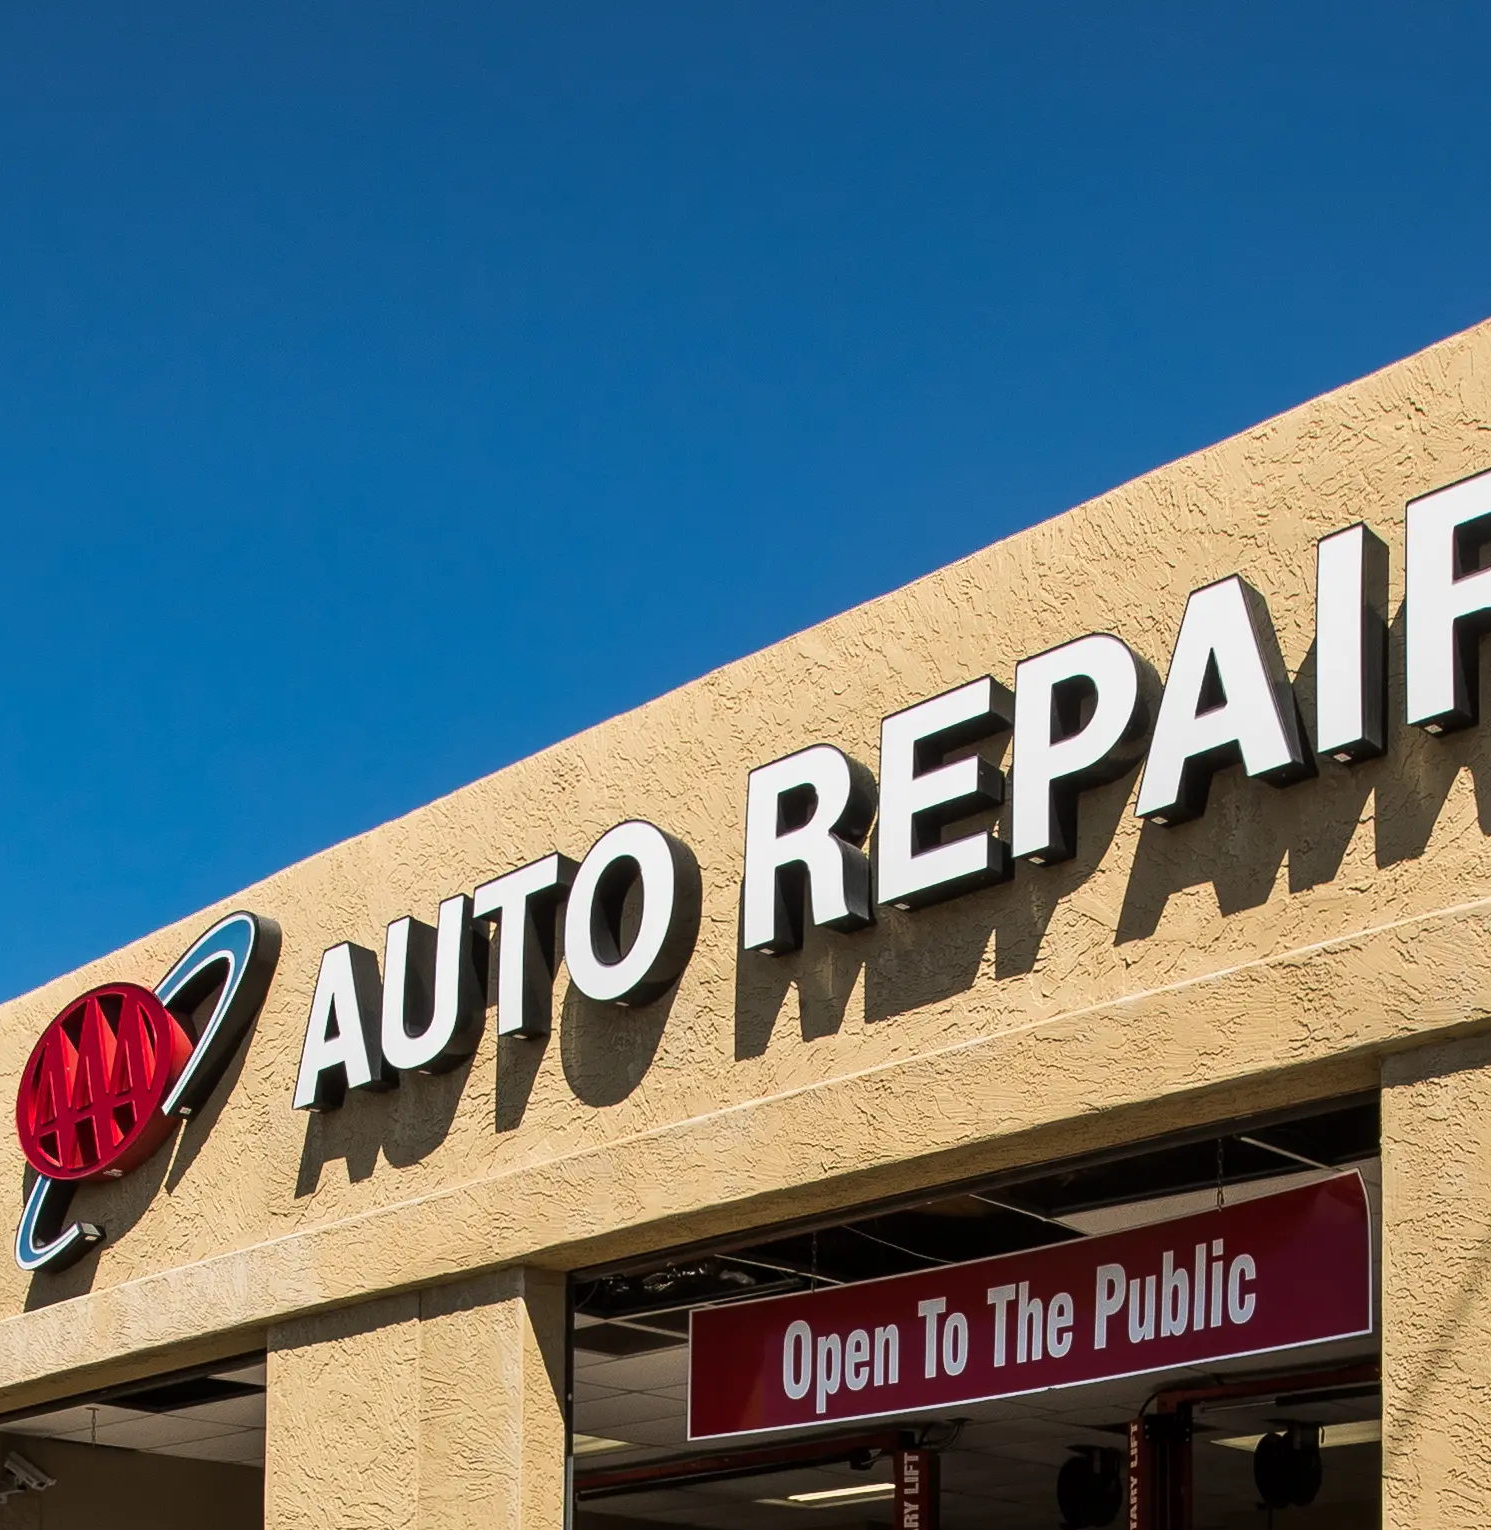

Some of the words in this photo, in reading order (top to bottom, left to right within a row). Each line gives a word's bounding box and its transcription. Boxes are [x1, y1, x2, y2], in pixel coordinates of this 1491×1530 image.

[293, 820, 678, 1112] AUTO
[16, 984, 170, 1178] AAA
[782, 1319, 900, 1415] Open
[918, 1296, 969, 1379] To
[986, 1280, 1075, 1368] The
[1093, 1238, 1257, 1350] Public
[903, 1452, 920, 1494] LIFT
[1129, 1423, 1138, 1468] LIFT
